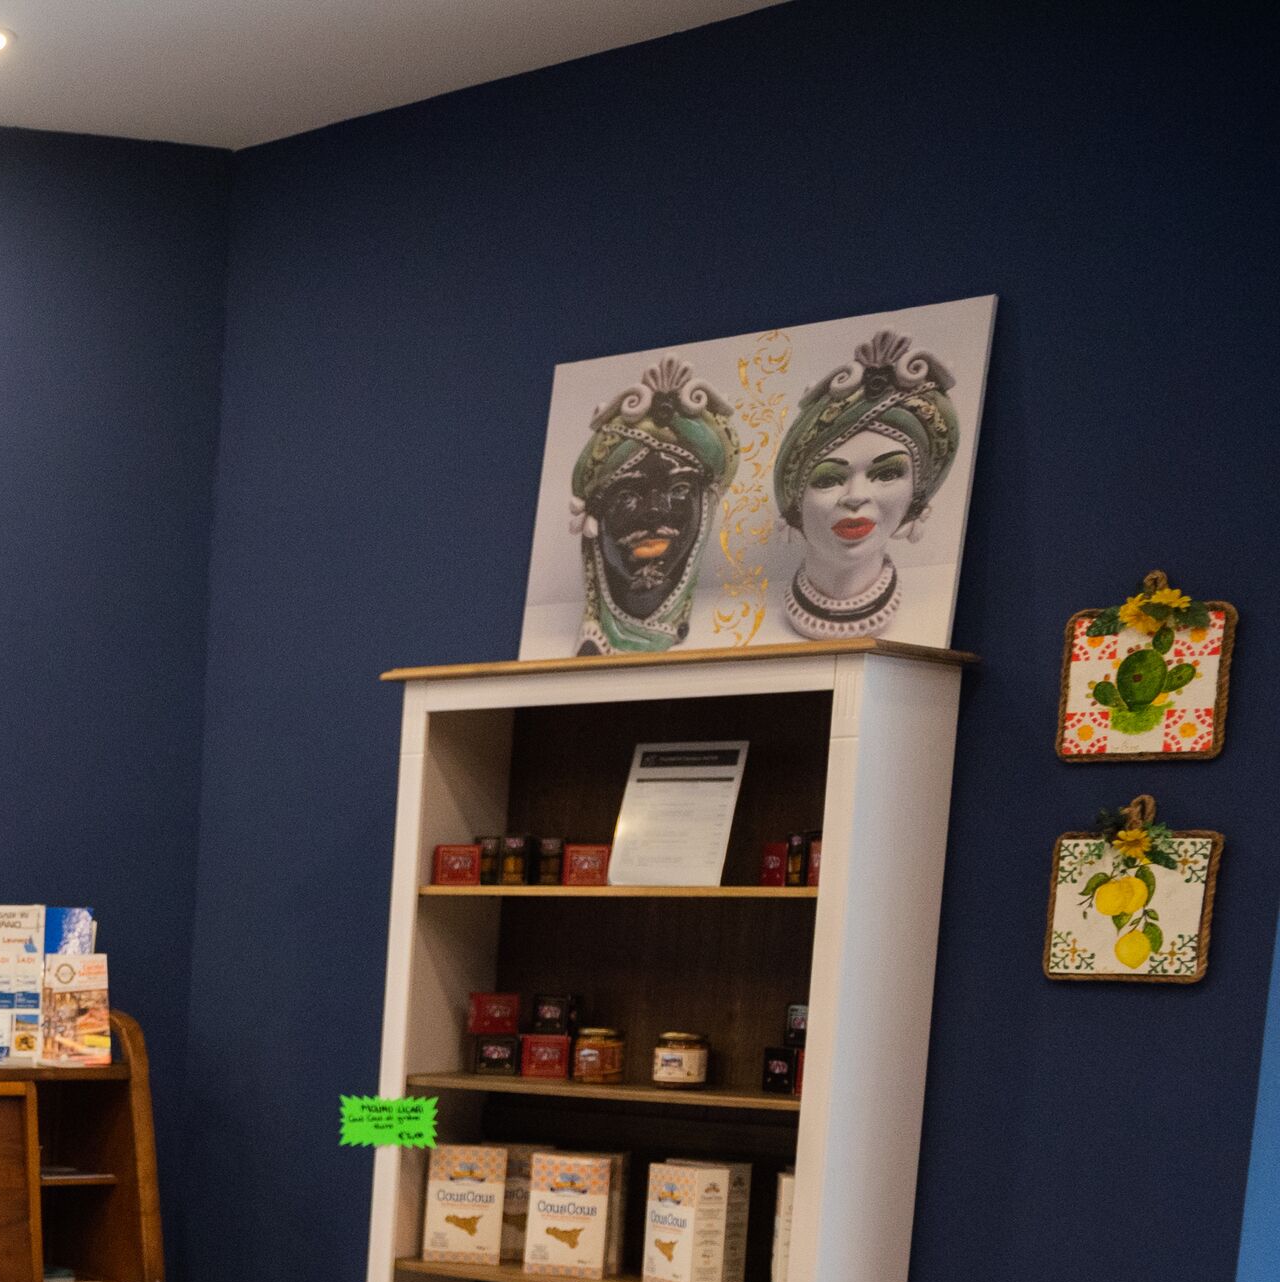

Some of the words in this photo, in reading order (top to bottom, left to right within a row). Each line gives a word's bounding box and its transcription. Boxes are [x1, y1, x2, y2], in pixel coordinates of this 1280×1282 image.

[437, 1189, 496, 1204] CousCous
[537, 1200, 598, 1217] CousCous
[649, 1210, 688, 1229] CousCous
